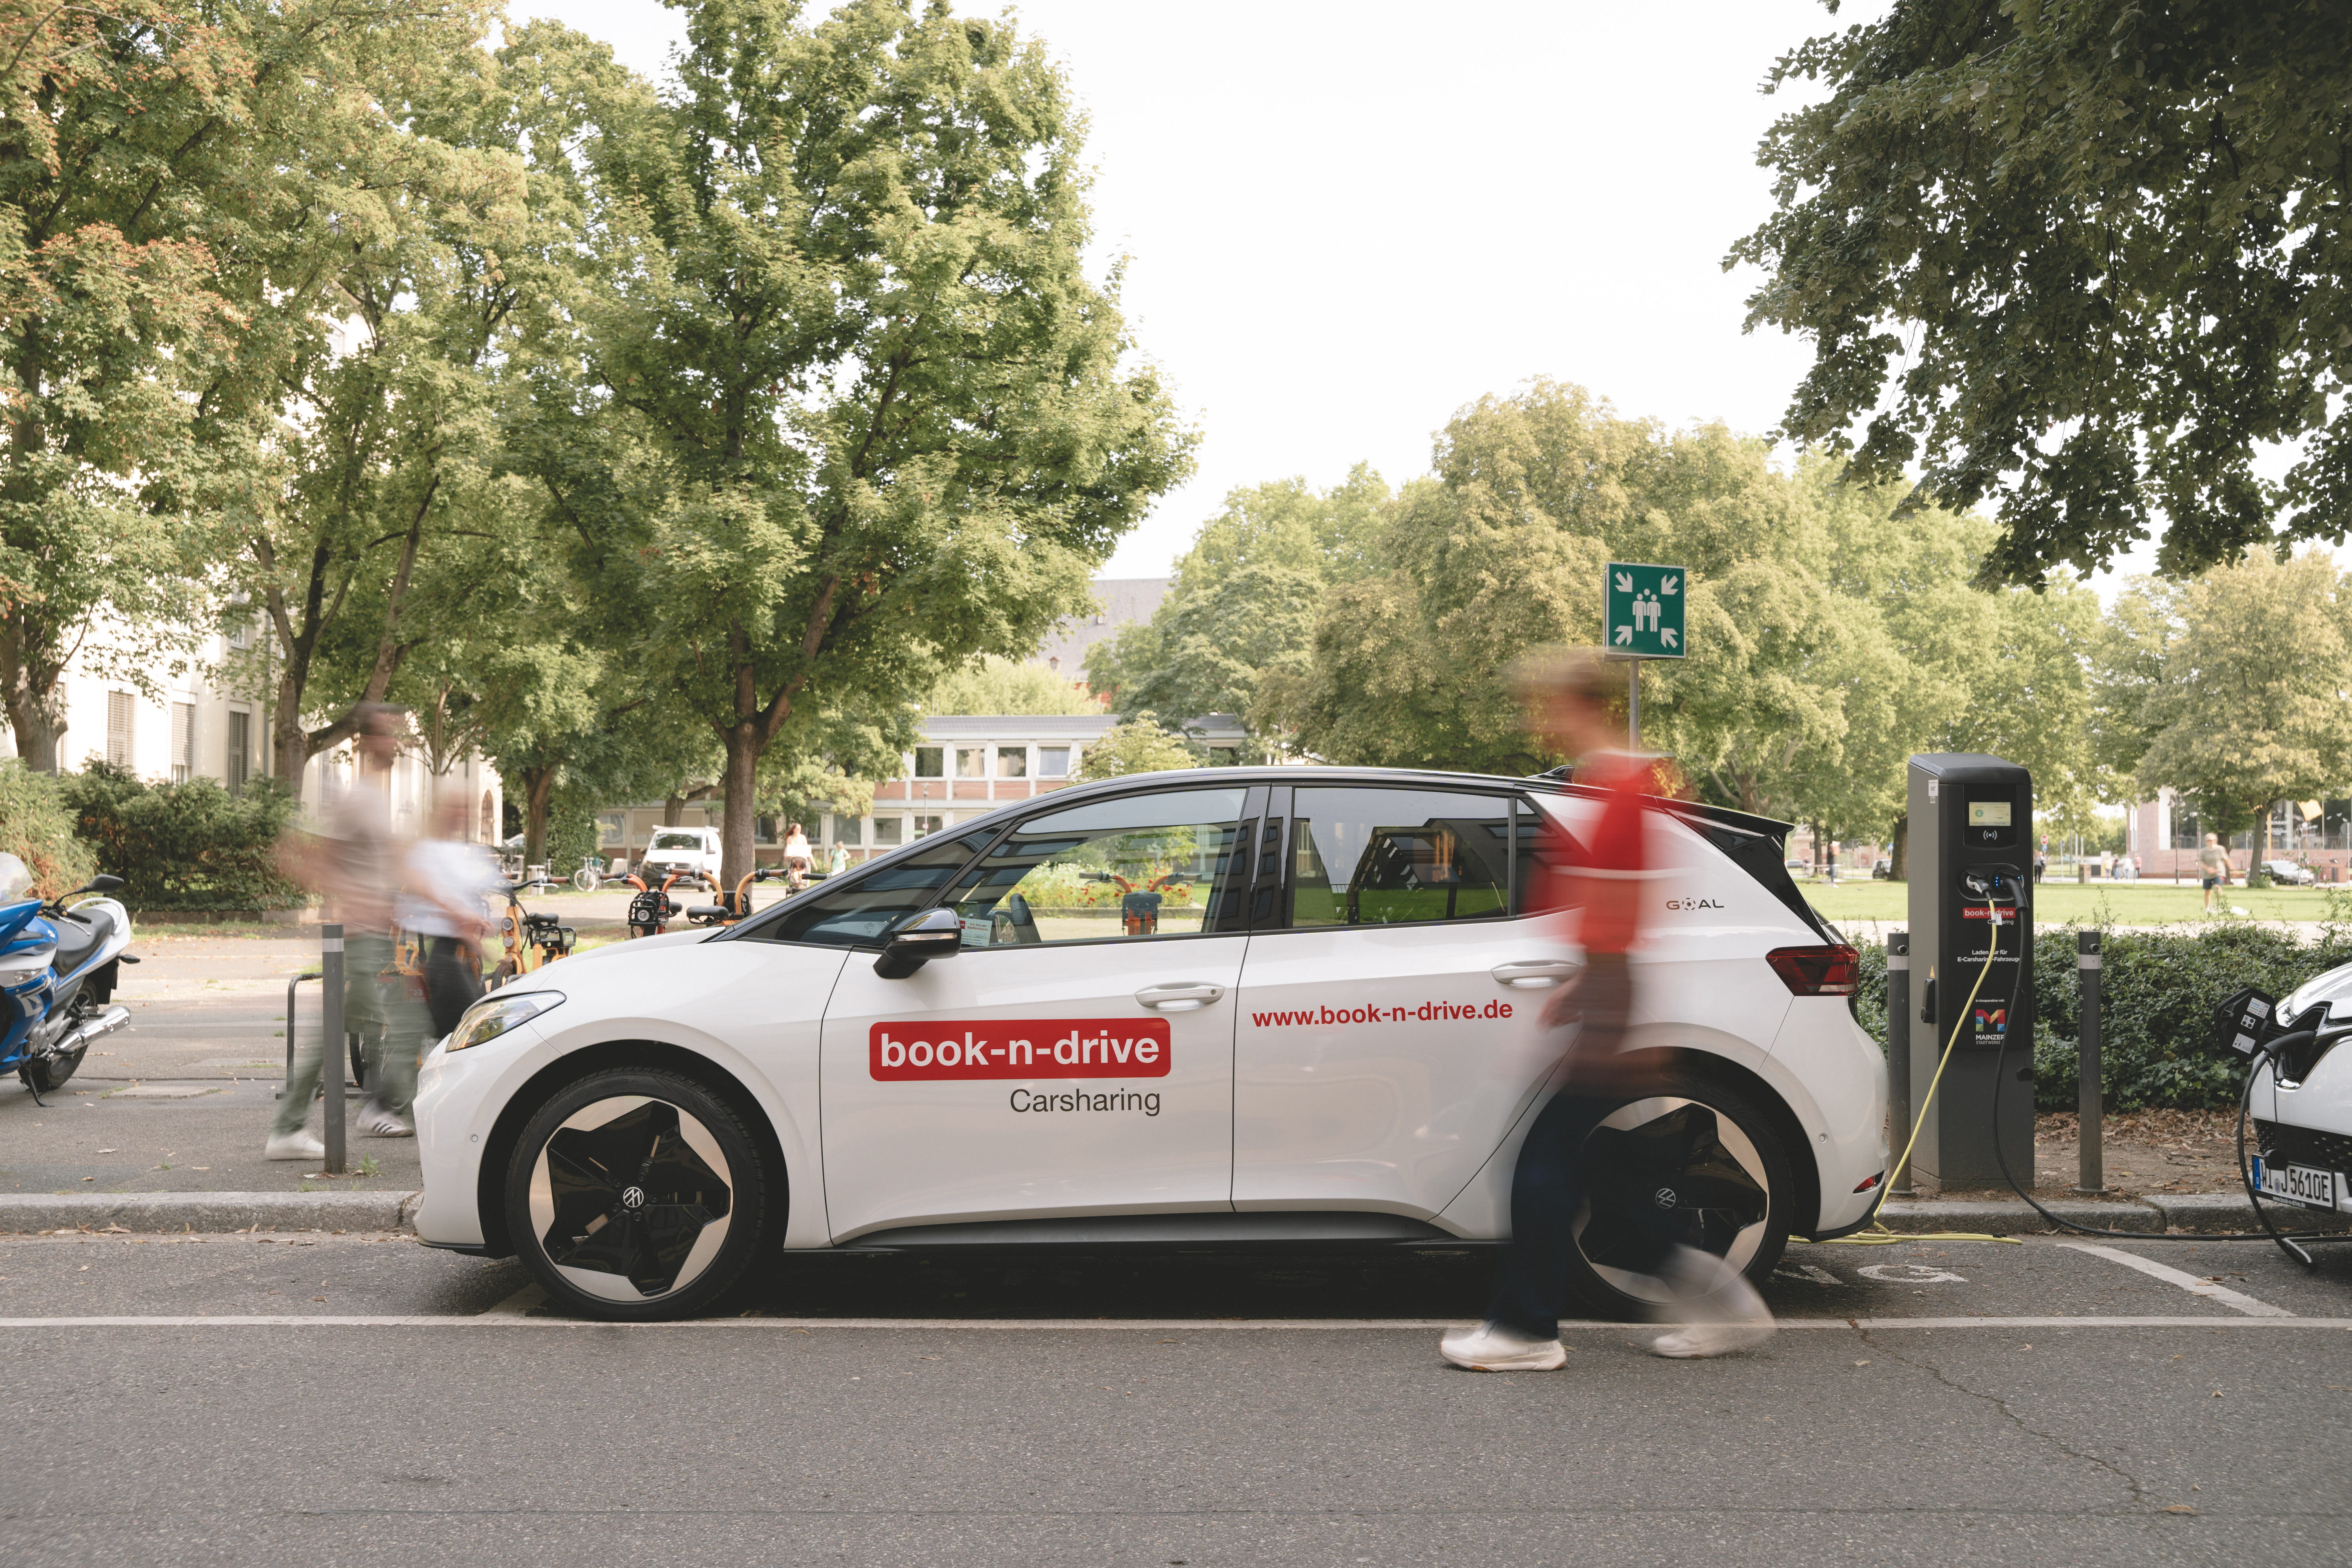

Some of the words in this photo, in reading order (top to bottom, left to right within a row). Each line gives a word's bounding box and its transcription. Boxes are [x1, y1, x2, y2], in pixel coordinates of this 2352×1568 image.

[1252, 999, 1513, 1027] www.book-n-drive.de
[881, 1030, 1160, 1067] book-n-drive
[1010, 1088, 1160, 1116] Carsharing
[2290, 1168, 2330, 1203] 5610E
[2273, 1196, 2306, 1208] www.book-n-drive.de
